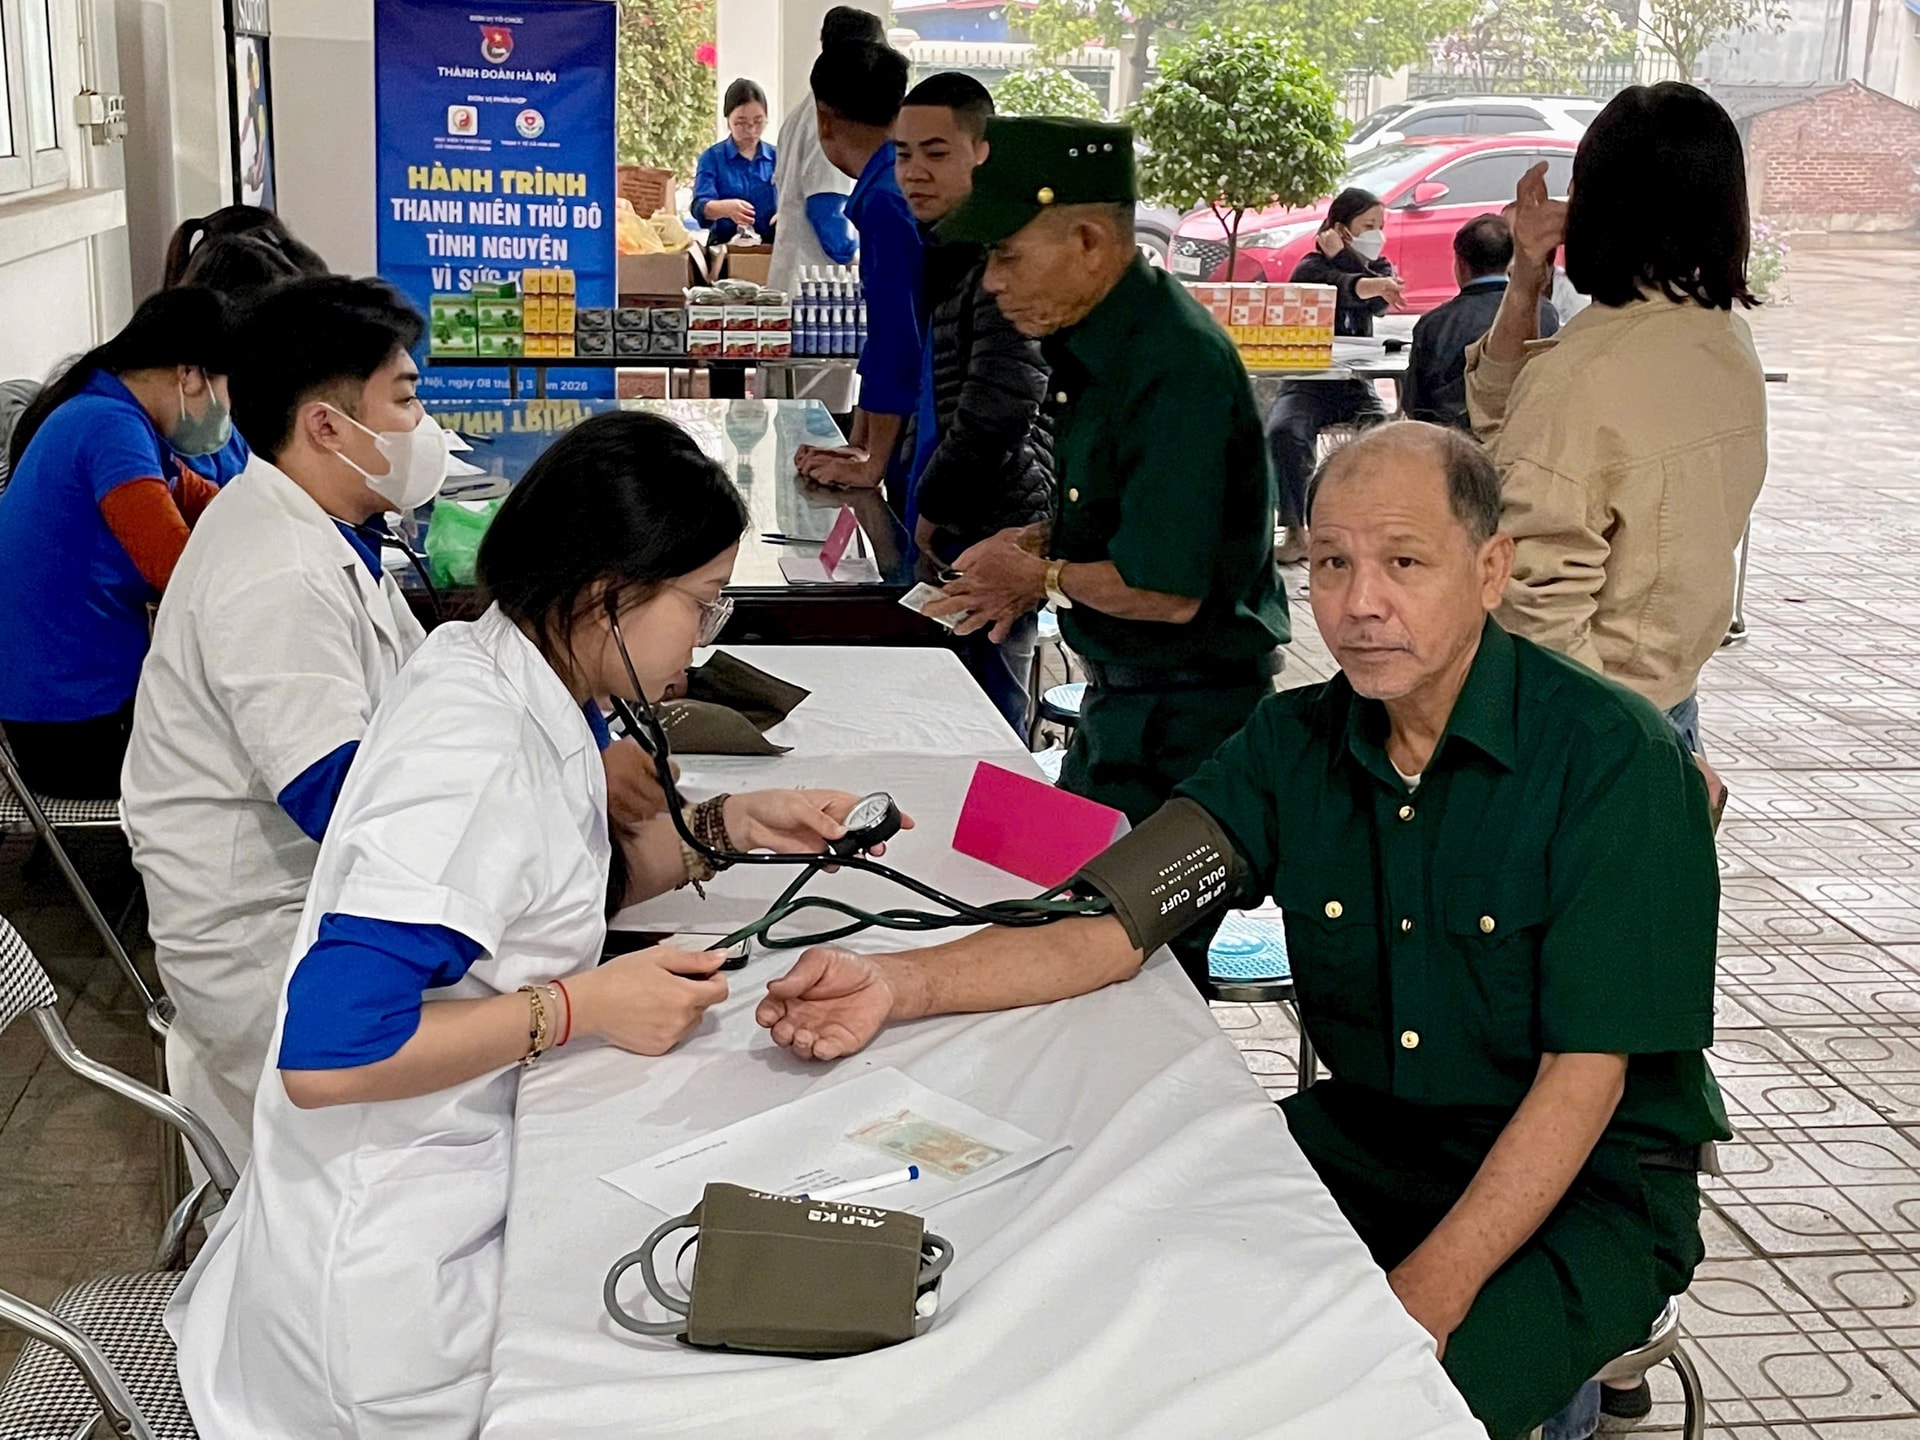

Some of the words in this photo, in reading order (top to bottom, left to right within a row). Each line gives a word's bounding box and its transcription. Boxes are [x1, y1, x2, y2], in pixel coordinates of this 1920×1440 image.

[437, 65, 479, 78] THÀNH
[480, 67, 515, 80] ĐOÀN
[516, 69, 534, 81] HÀ
[535, 70, 557, 84] NỘI
[408, 161, 493, 194] HÀNH
[500, 166, 587, 197] TRÌNH
[390, 198, 463, 223] THANH
[469, 198, 521, 226] NIÊN
[526, 198, 566, 228] THỦ
[573, 202, 602, 229] ĐÔ
[426, 229, 475, 258] TÌNH
[482, 234, 568, 265] NGUYỆN
[431, 263, 452, 291] VÌ
[448, 377, 475, 390] ngày
[526, 379, 534, 389] 3
[1199, 865, 1226, 892] DULT
[1160, 889, 1190, 915] CUFF
[818, 1202, 888, 1218] ADULT
